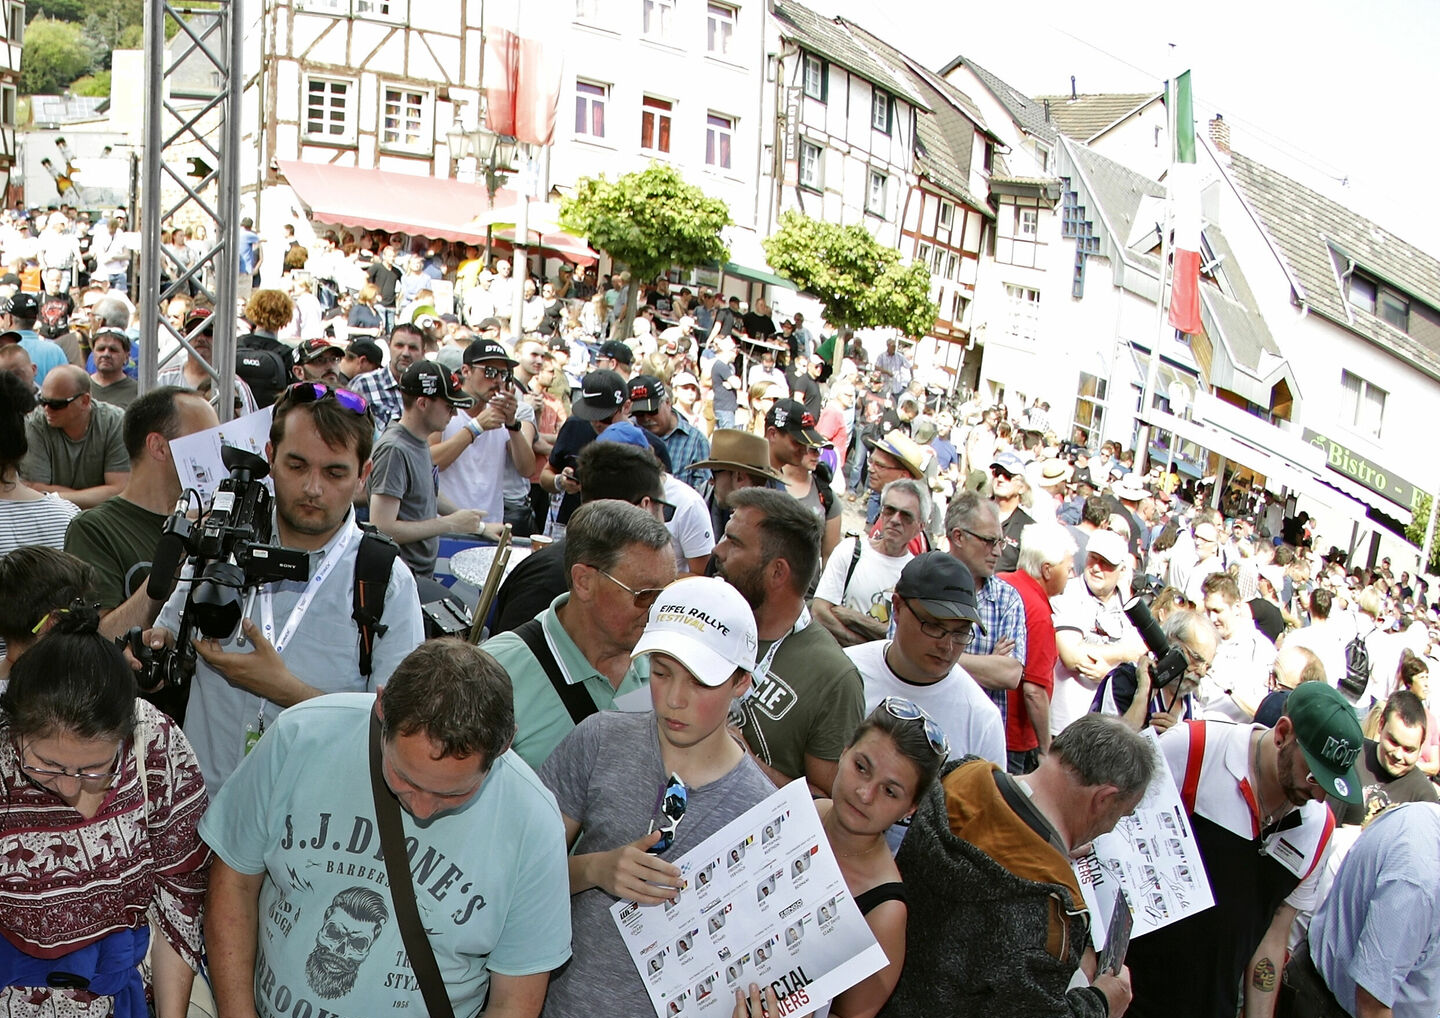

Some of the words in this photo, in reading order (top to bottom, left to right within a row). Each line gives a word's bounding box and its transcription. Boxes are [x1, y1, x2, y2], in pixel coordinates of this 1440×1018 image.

[1327, 440, 1388, 491] Bistro
[279, 562, 297, 570] SONY
[655, 614, 706, 634] FESTIVAL
[659, 604, 687, 614] EIFEL
[688, 607, 730, 637] RALLYE
[325, 859, 392, 889] BARBERS
